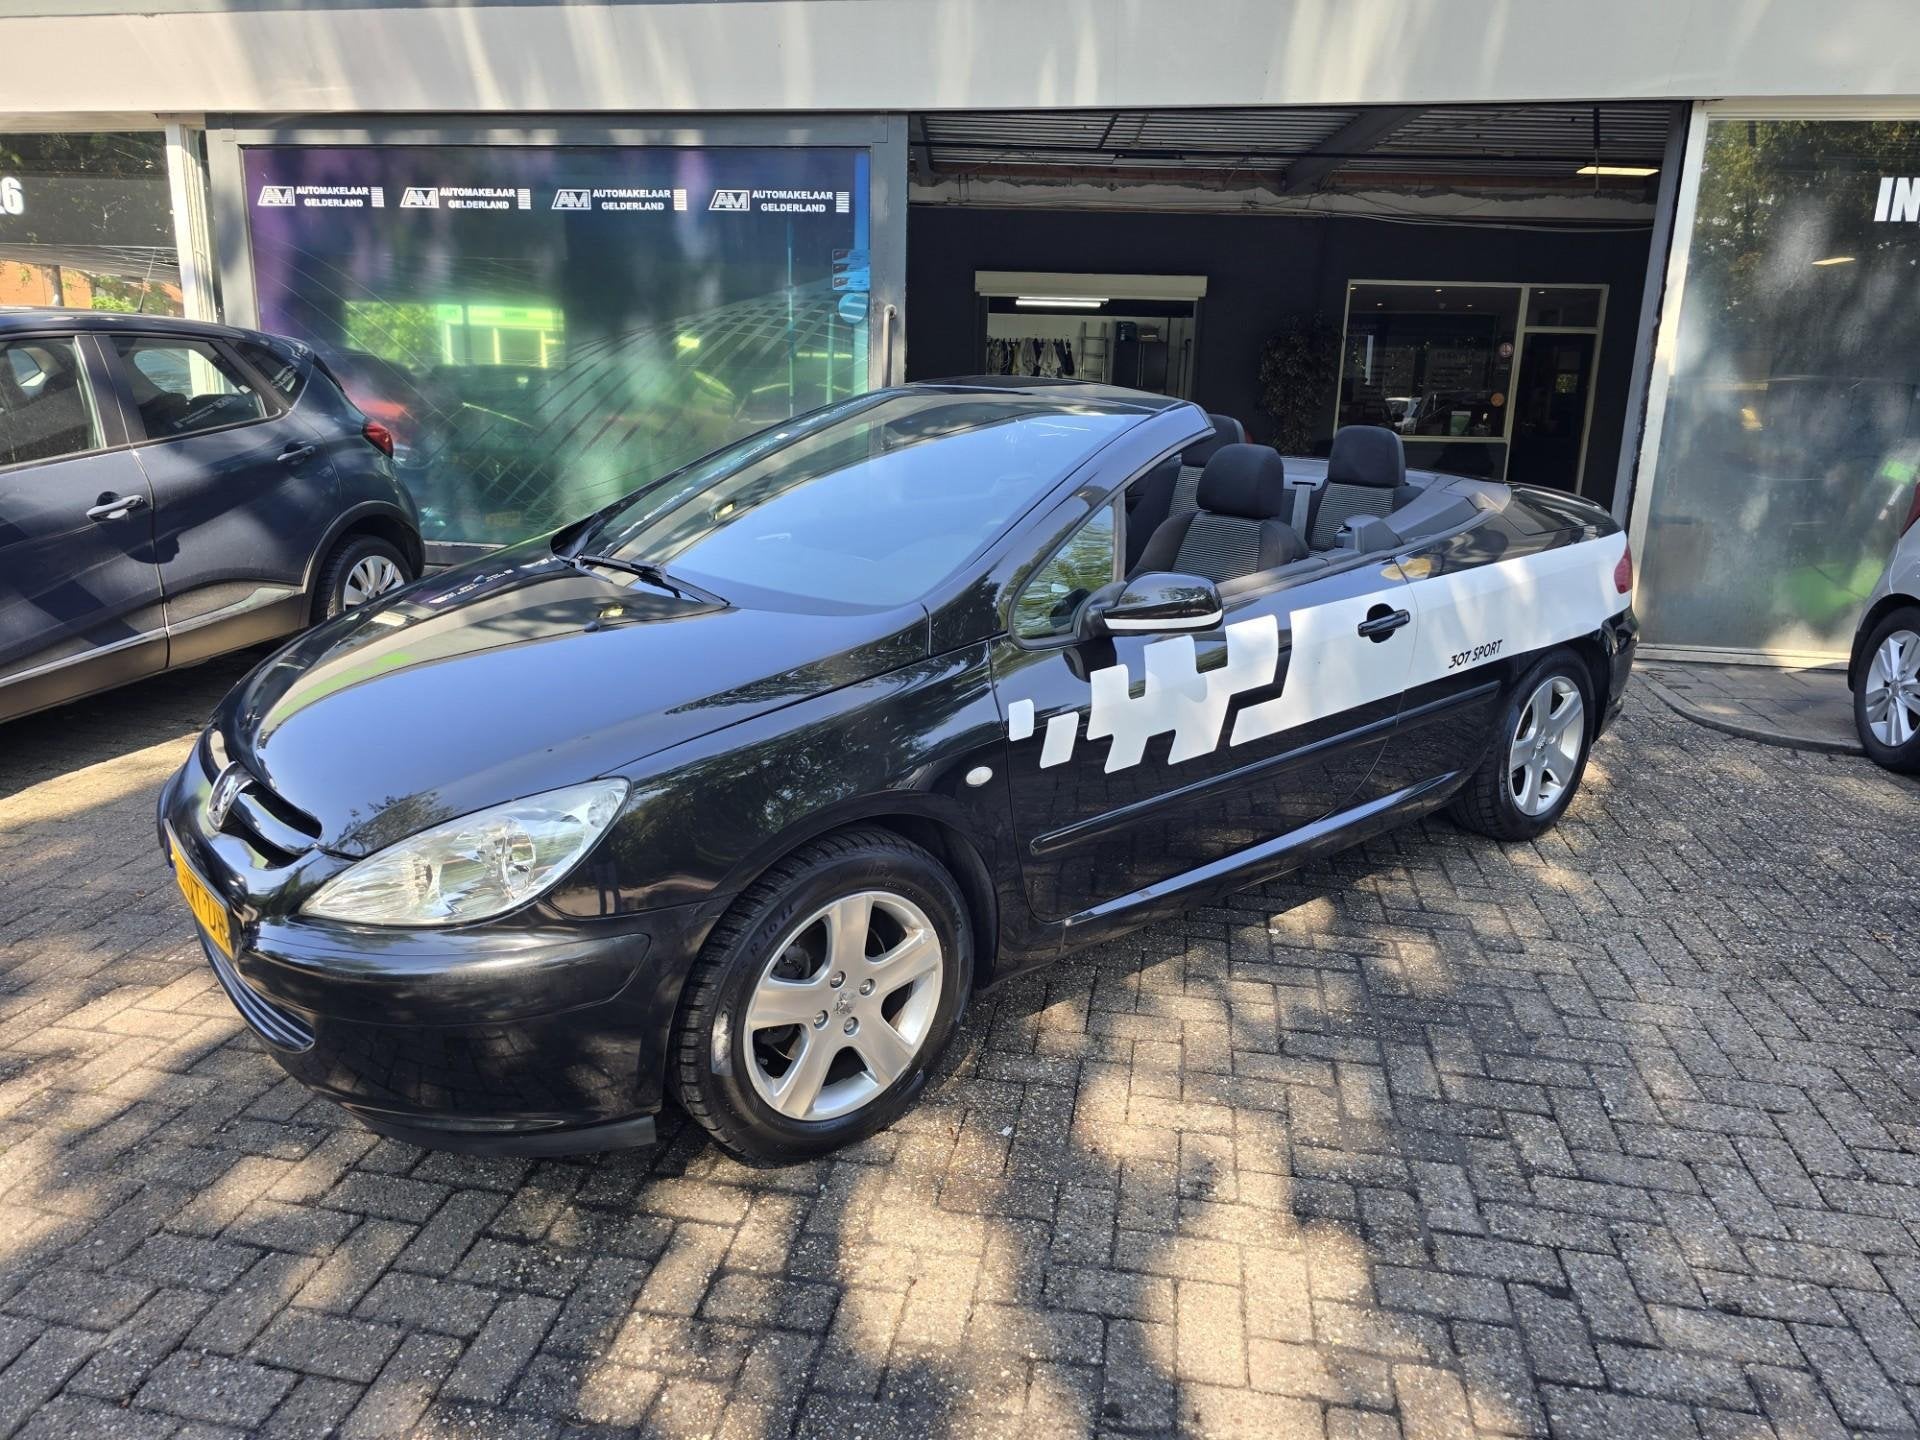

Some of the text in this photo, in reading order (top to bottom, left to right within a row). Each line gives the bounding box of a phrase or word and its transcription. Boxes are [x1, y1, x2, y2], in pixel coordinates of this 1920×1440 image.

[0, 176, 24, 215] 6
[296, 186, 370, 195] AUTOMAKELAAR
[440, 187, 516, 197] AUTOMAKELAAR
[592, 188, 672, 198] AUTOMAKELAAR
[752, 190, 834, 200] AUTOMAKELAAR
[304, 198, 364, 207] GELDERLAND
[448, 200, 510, 209] GELDERLAND
[601, 201, 665, 211] GELDERLAND
[761, 202, 826, 212] GELDERLAND
[1448, 639, 1503, 669] 307 SPORT
